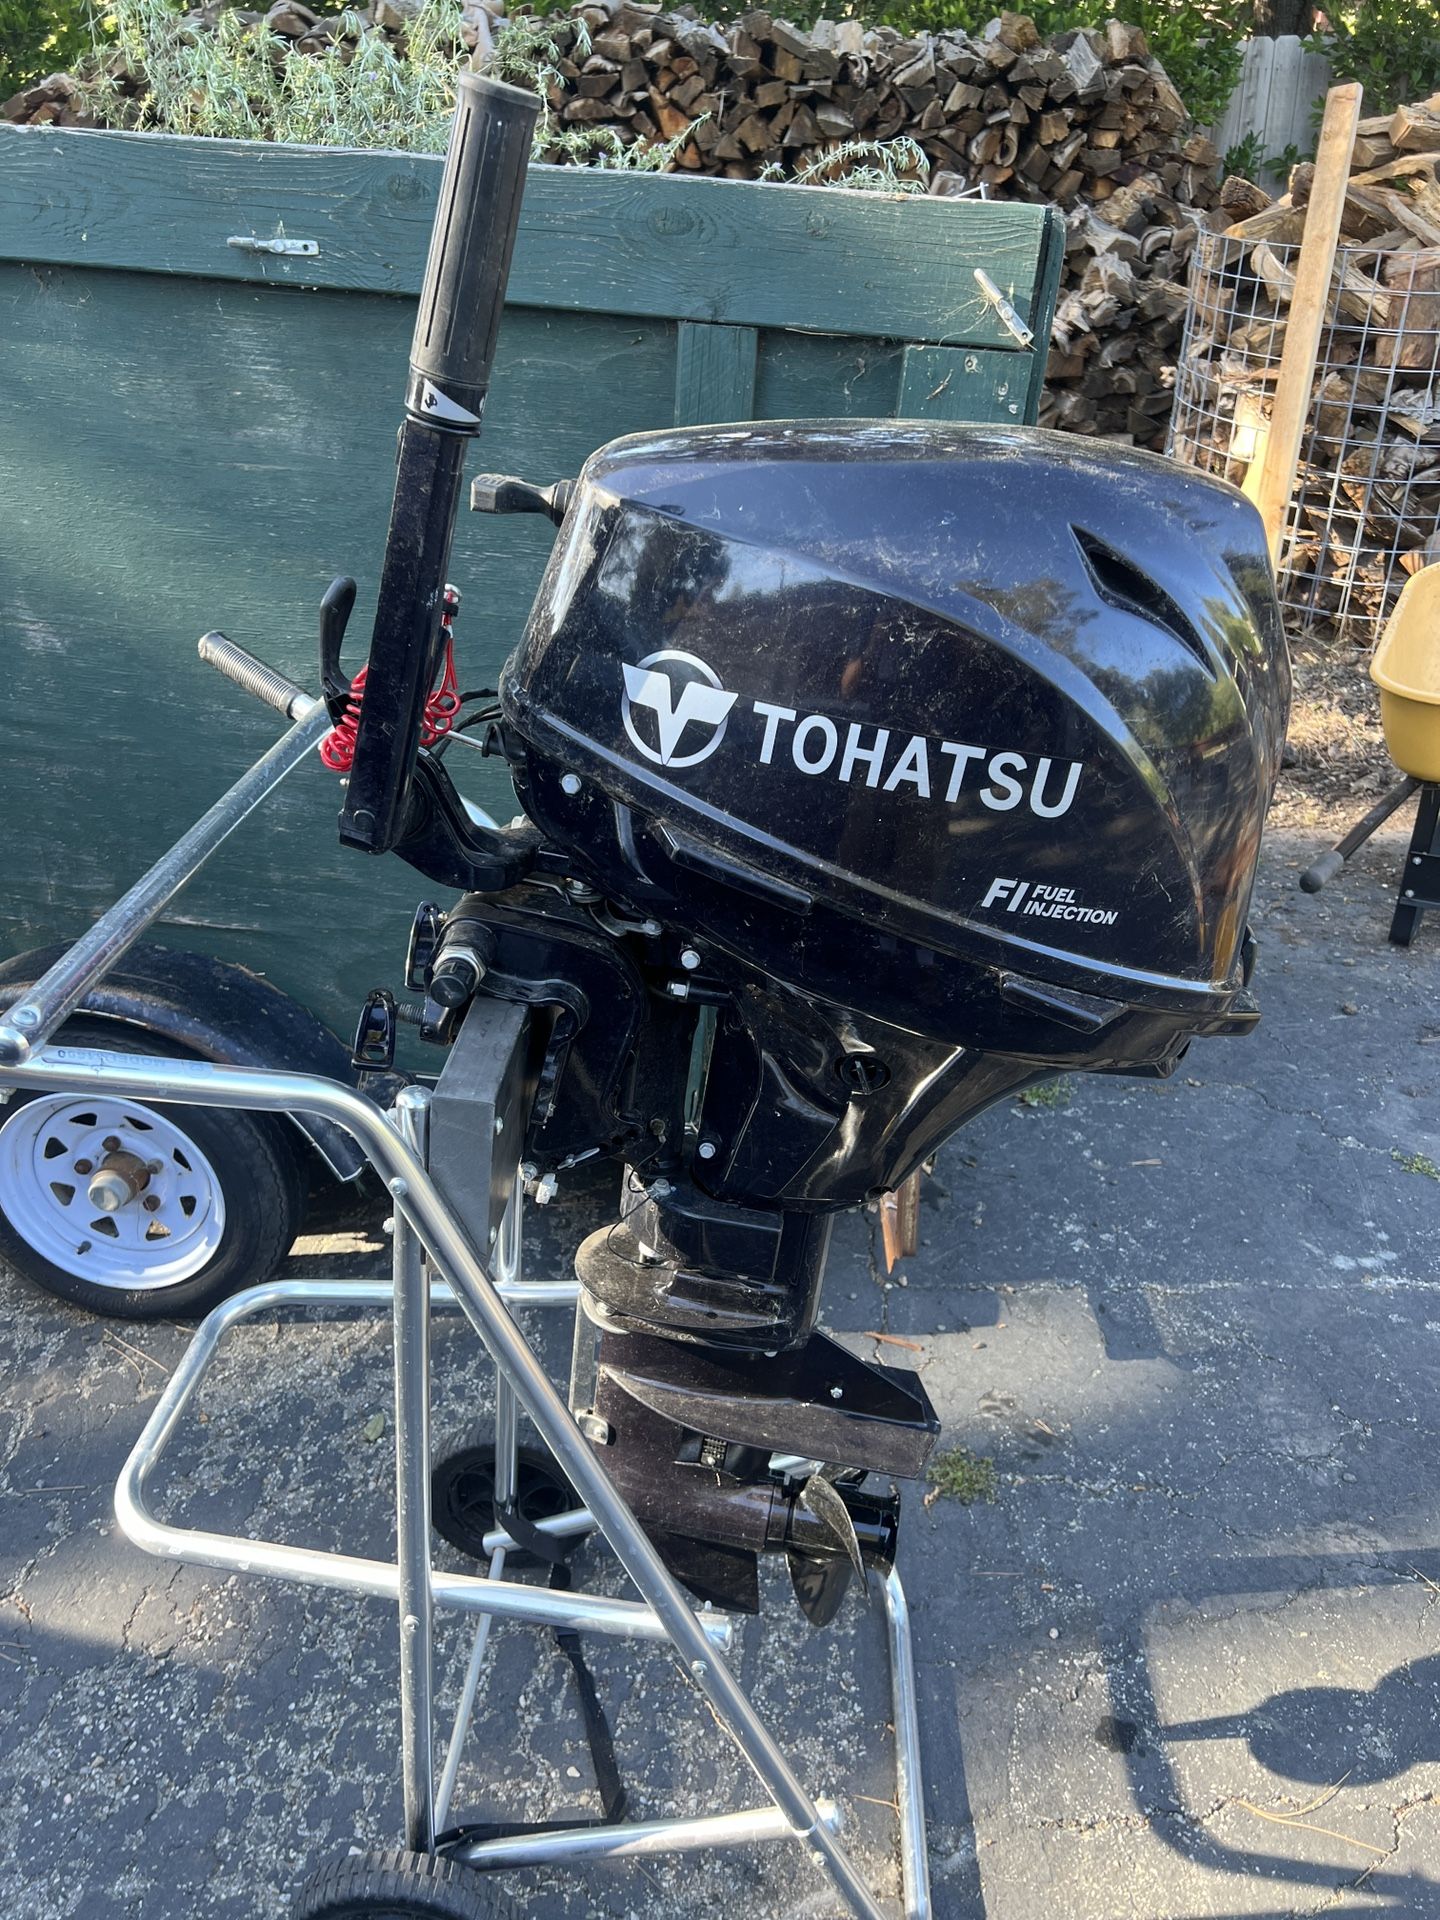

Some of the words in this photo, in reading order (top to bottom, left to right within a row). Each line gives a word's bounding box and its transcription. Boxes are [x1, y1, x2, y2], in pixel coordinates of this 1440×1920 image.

[752, 700, 1084, 819] TOHATSU
[980, 877, 1030, 912] FI
[1031, 884, 1076, 904] FUEL
[1022, 900, 1119, 925] INJECTION
